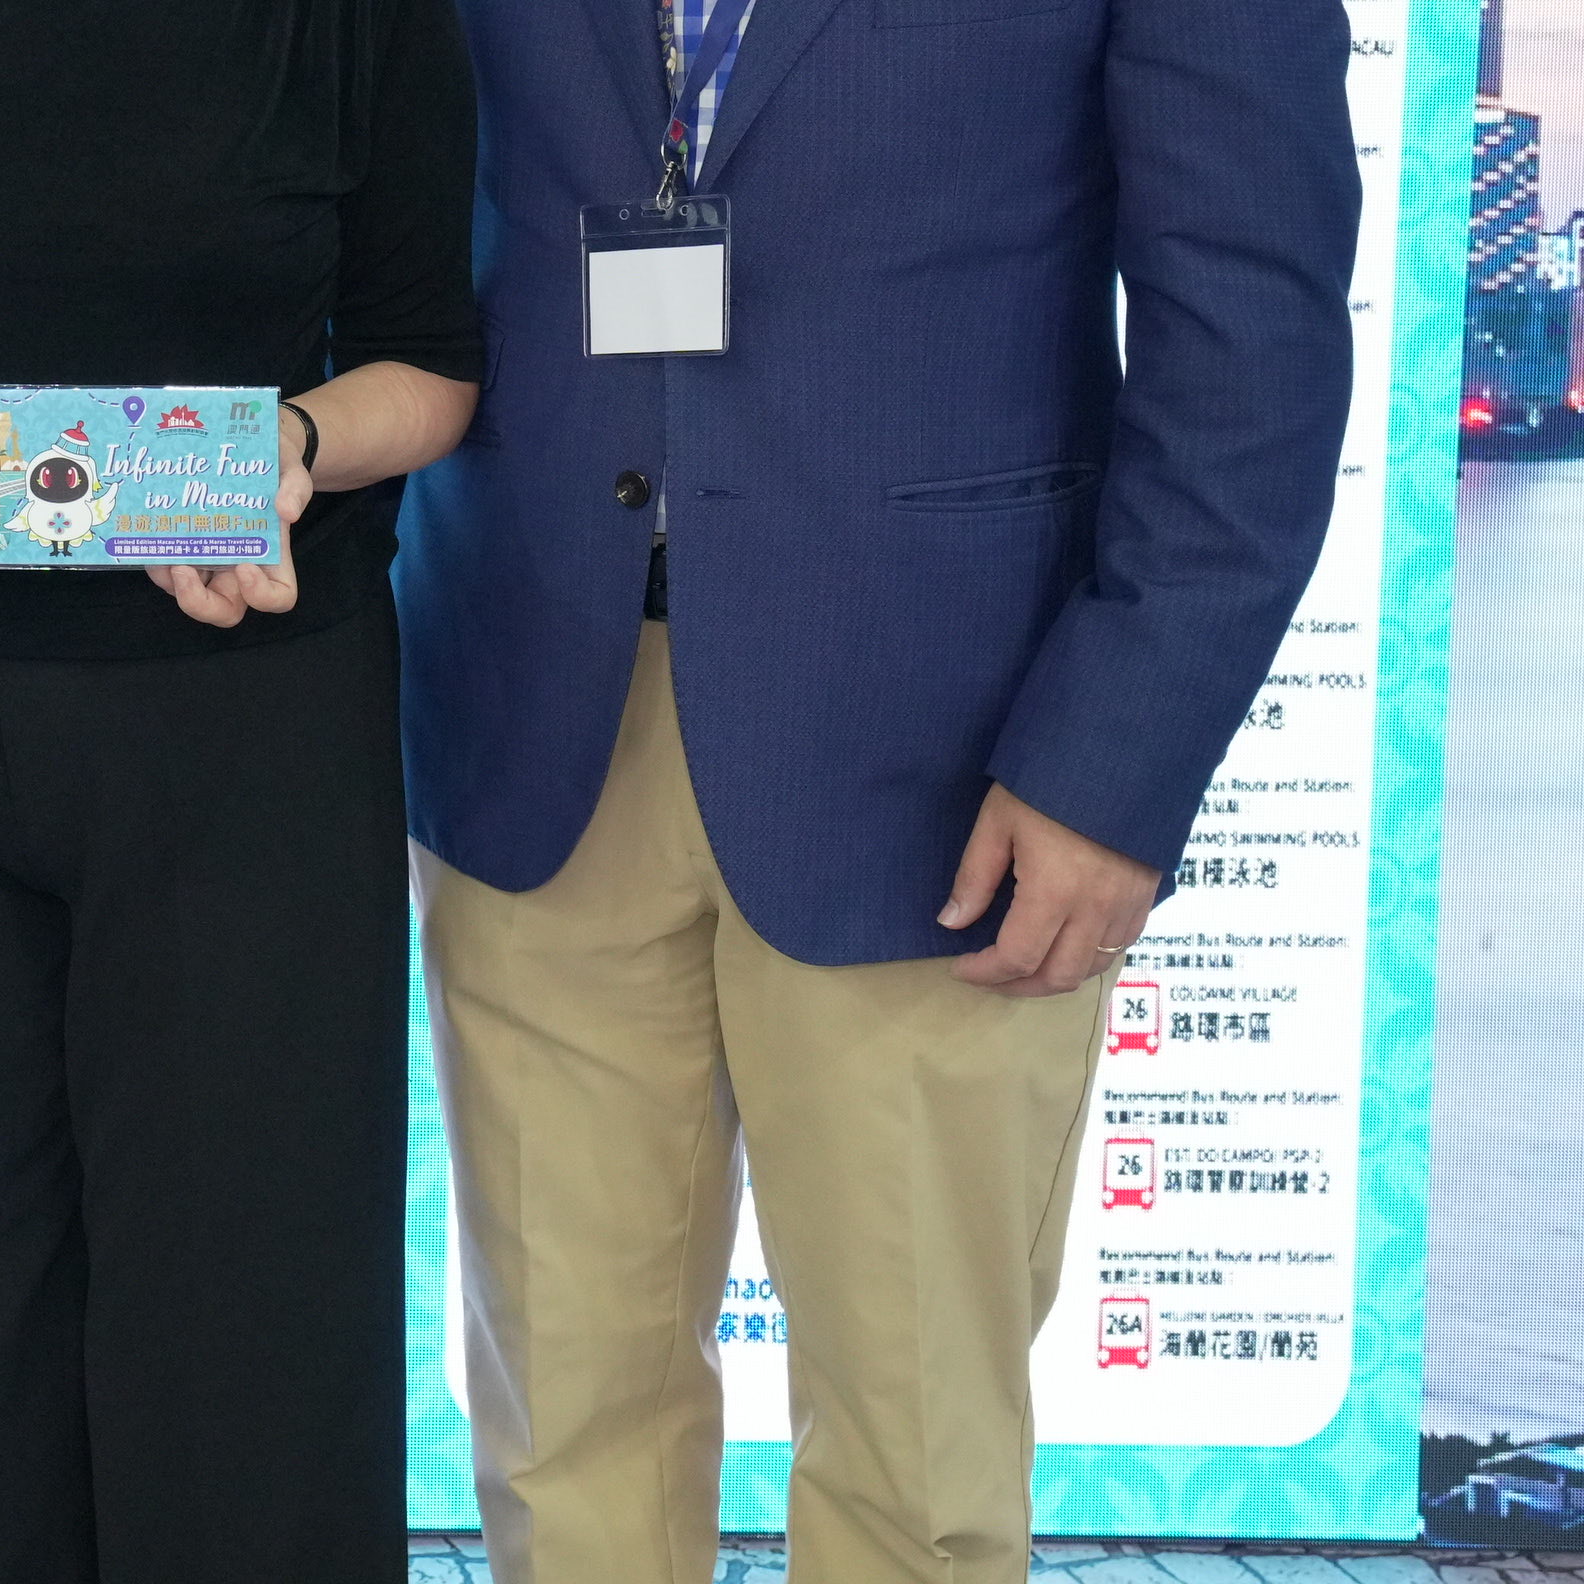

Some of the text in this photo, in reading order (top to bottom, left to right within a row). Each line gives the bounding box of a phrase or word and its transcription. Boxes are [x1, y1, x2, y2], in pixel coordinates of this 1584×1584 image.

[100, 443, 274, 483] Infinite Fun
[144, 480, 270, 511] in Macau
[1105, 1314, 1143, 1336] 26A
